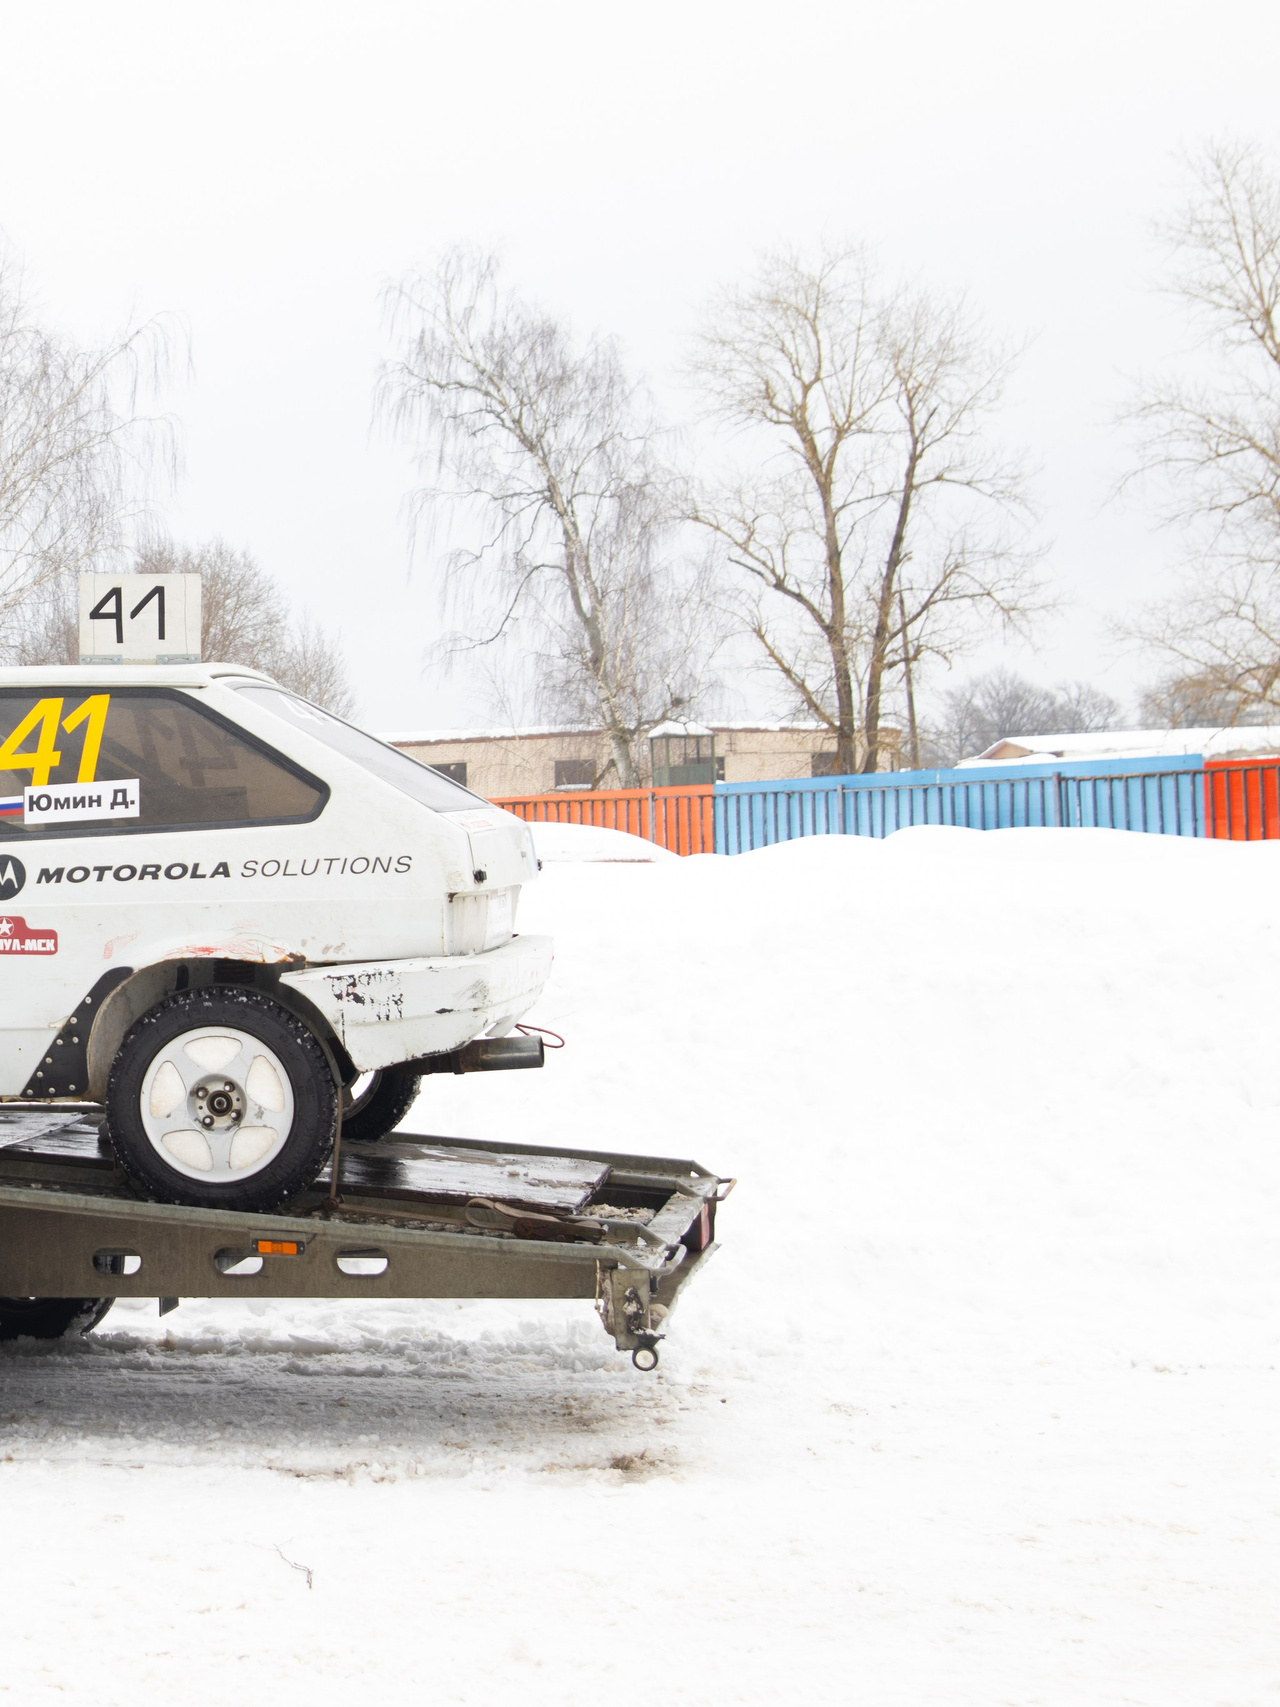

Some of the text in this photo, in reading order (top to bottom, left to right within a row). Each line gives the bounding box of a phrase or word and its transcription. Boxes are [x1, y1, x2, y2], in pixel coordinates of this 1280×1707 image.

[88, 585, 166, 644] 41
[28, 788, 136, 812] Юмин Д.
[36, 855, 413, 884] MOTOROLA SOLUTIONS
